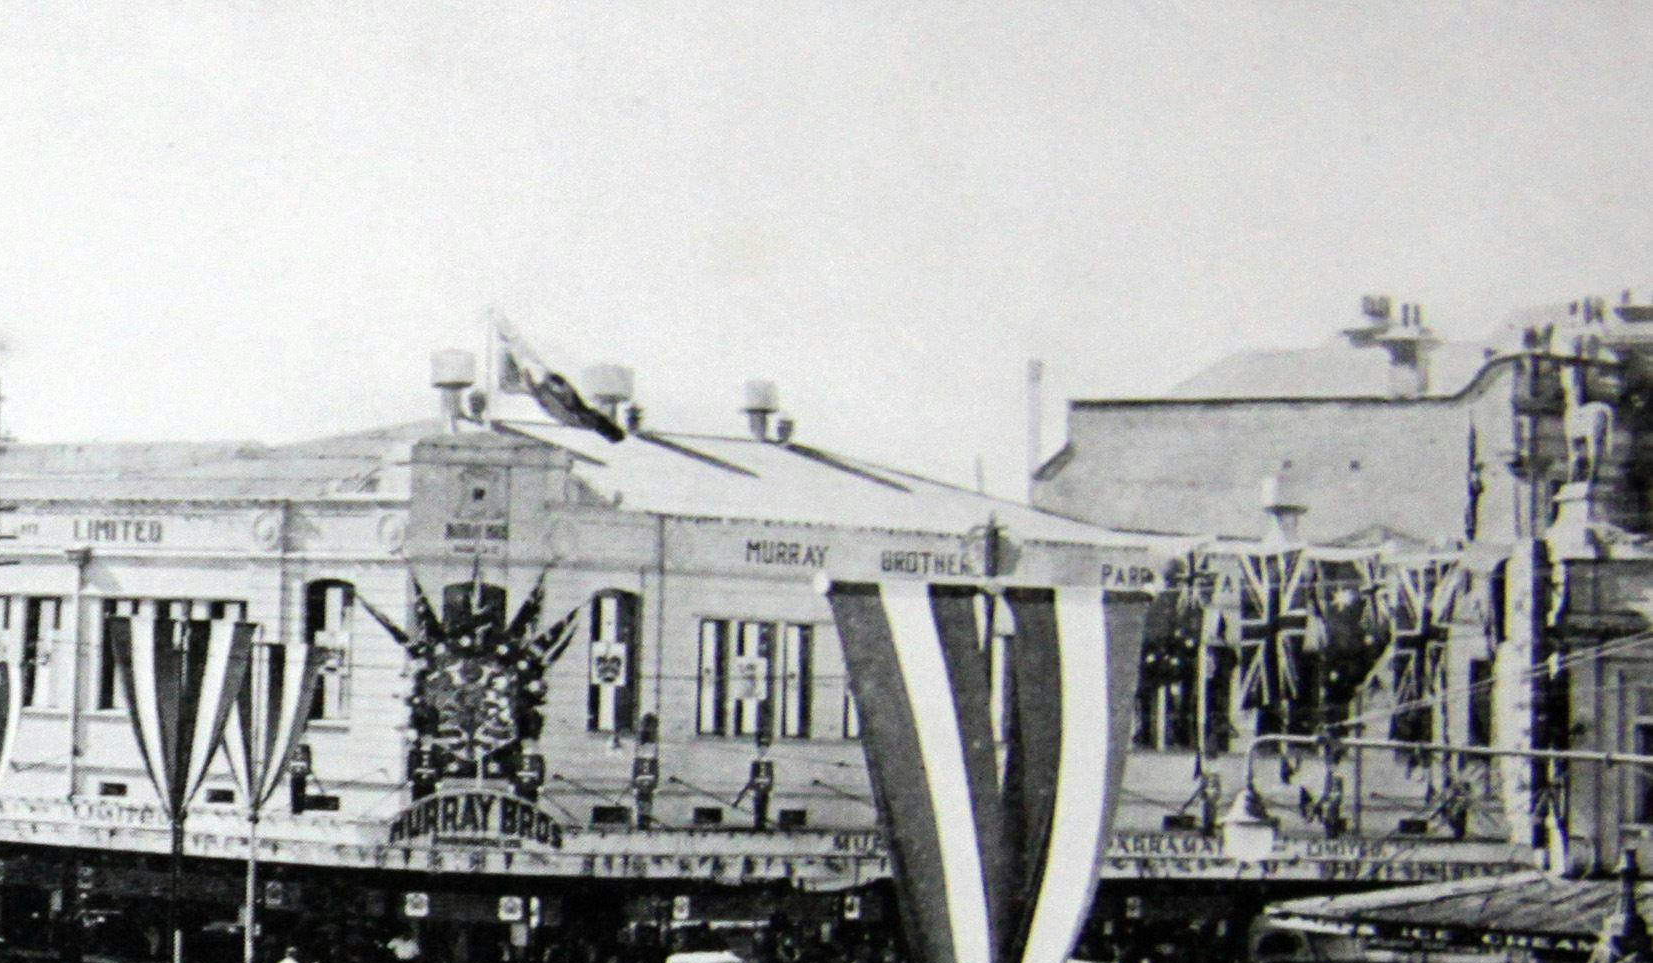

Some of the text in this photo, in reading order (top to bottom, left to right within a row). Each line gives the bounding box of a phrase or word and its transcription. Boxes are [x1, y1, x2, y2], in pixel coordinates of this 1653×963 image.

[73, 518, 163, 543] LIMITED
[746, 539, 828, 568] MURRAY
[881, 551, 980, 577] BROTHER
[389, 794, 563, 849] MURRAY BROS
